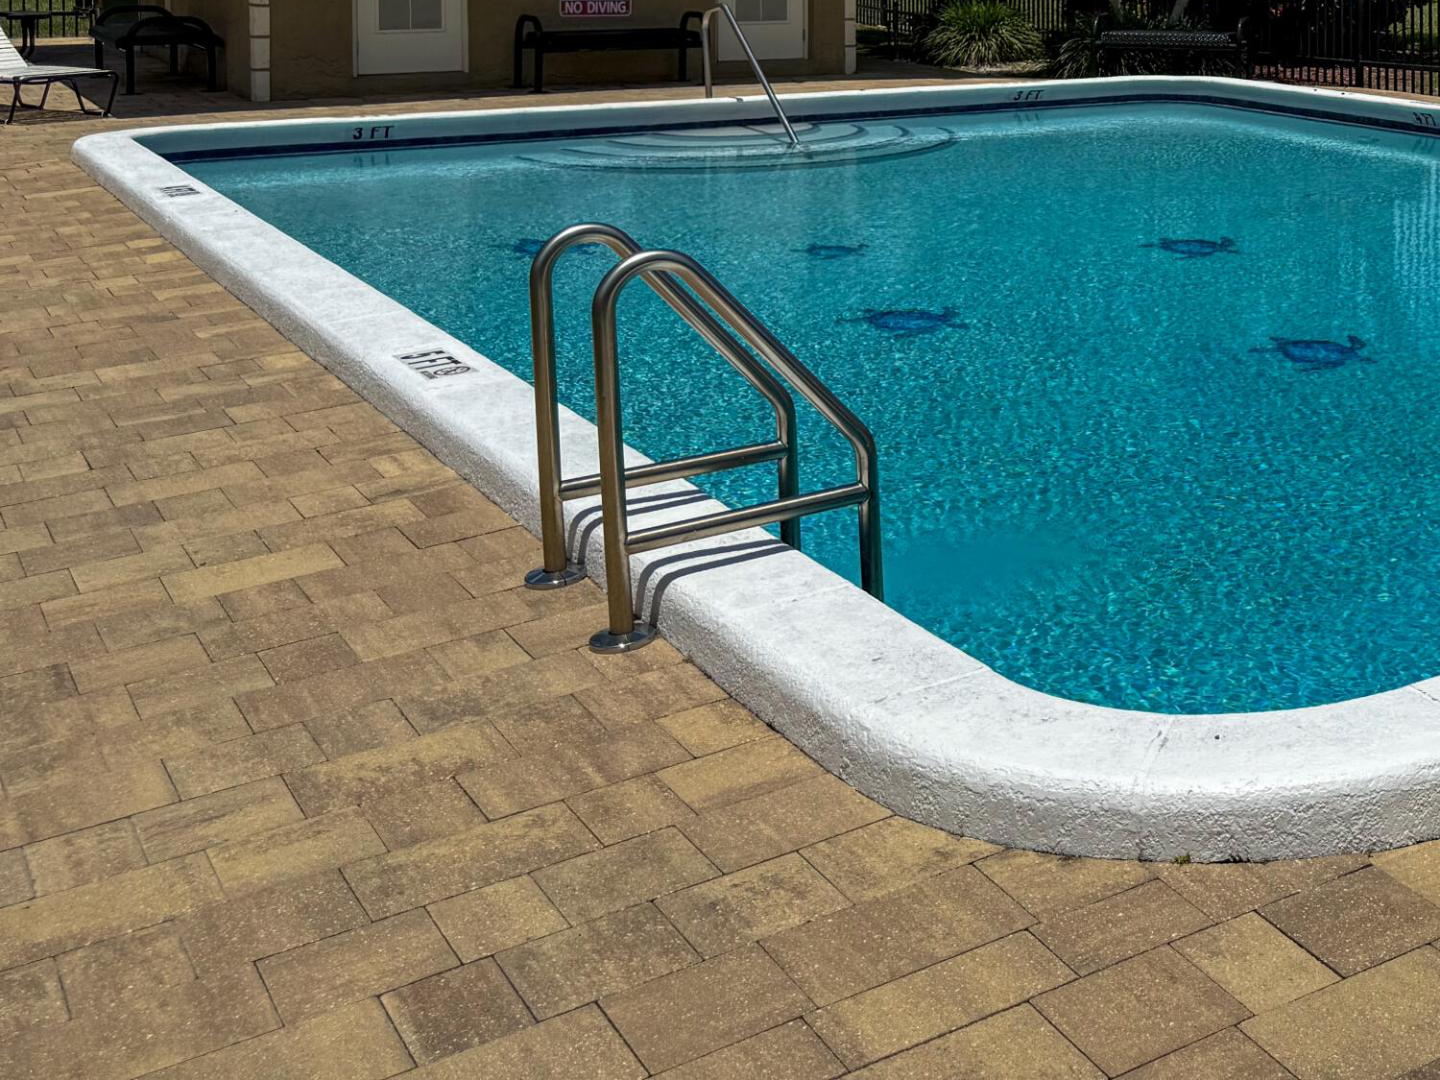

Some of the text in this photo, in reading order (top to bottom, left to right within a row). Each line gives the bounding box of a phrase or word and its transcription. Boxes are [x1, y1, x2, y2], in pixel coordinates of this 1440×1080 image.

[565, 1, 627, 14] NO DIVING
[1025, 89, 1045, 101] FT
[352, 124, 396, 140] 3 FT
